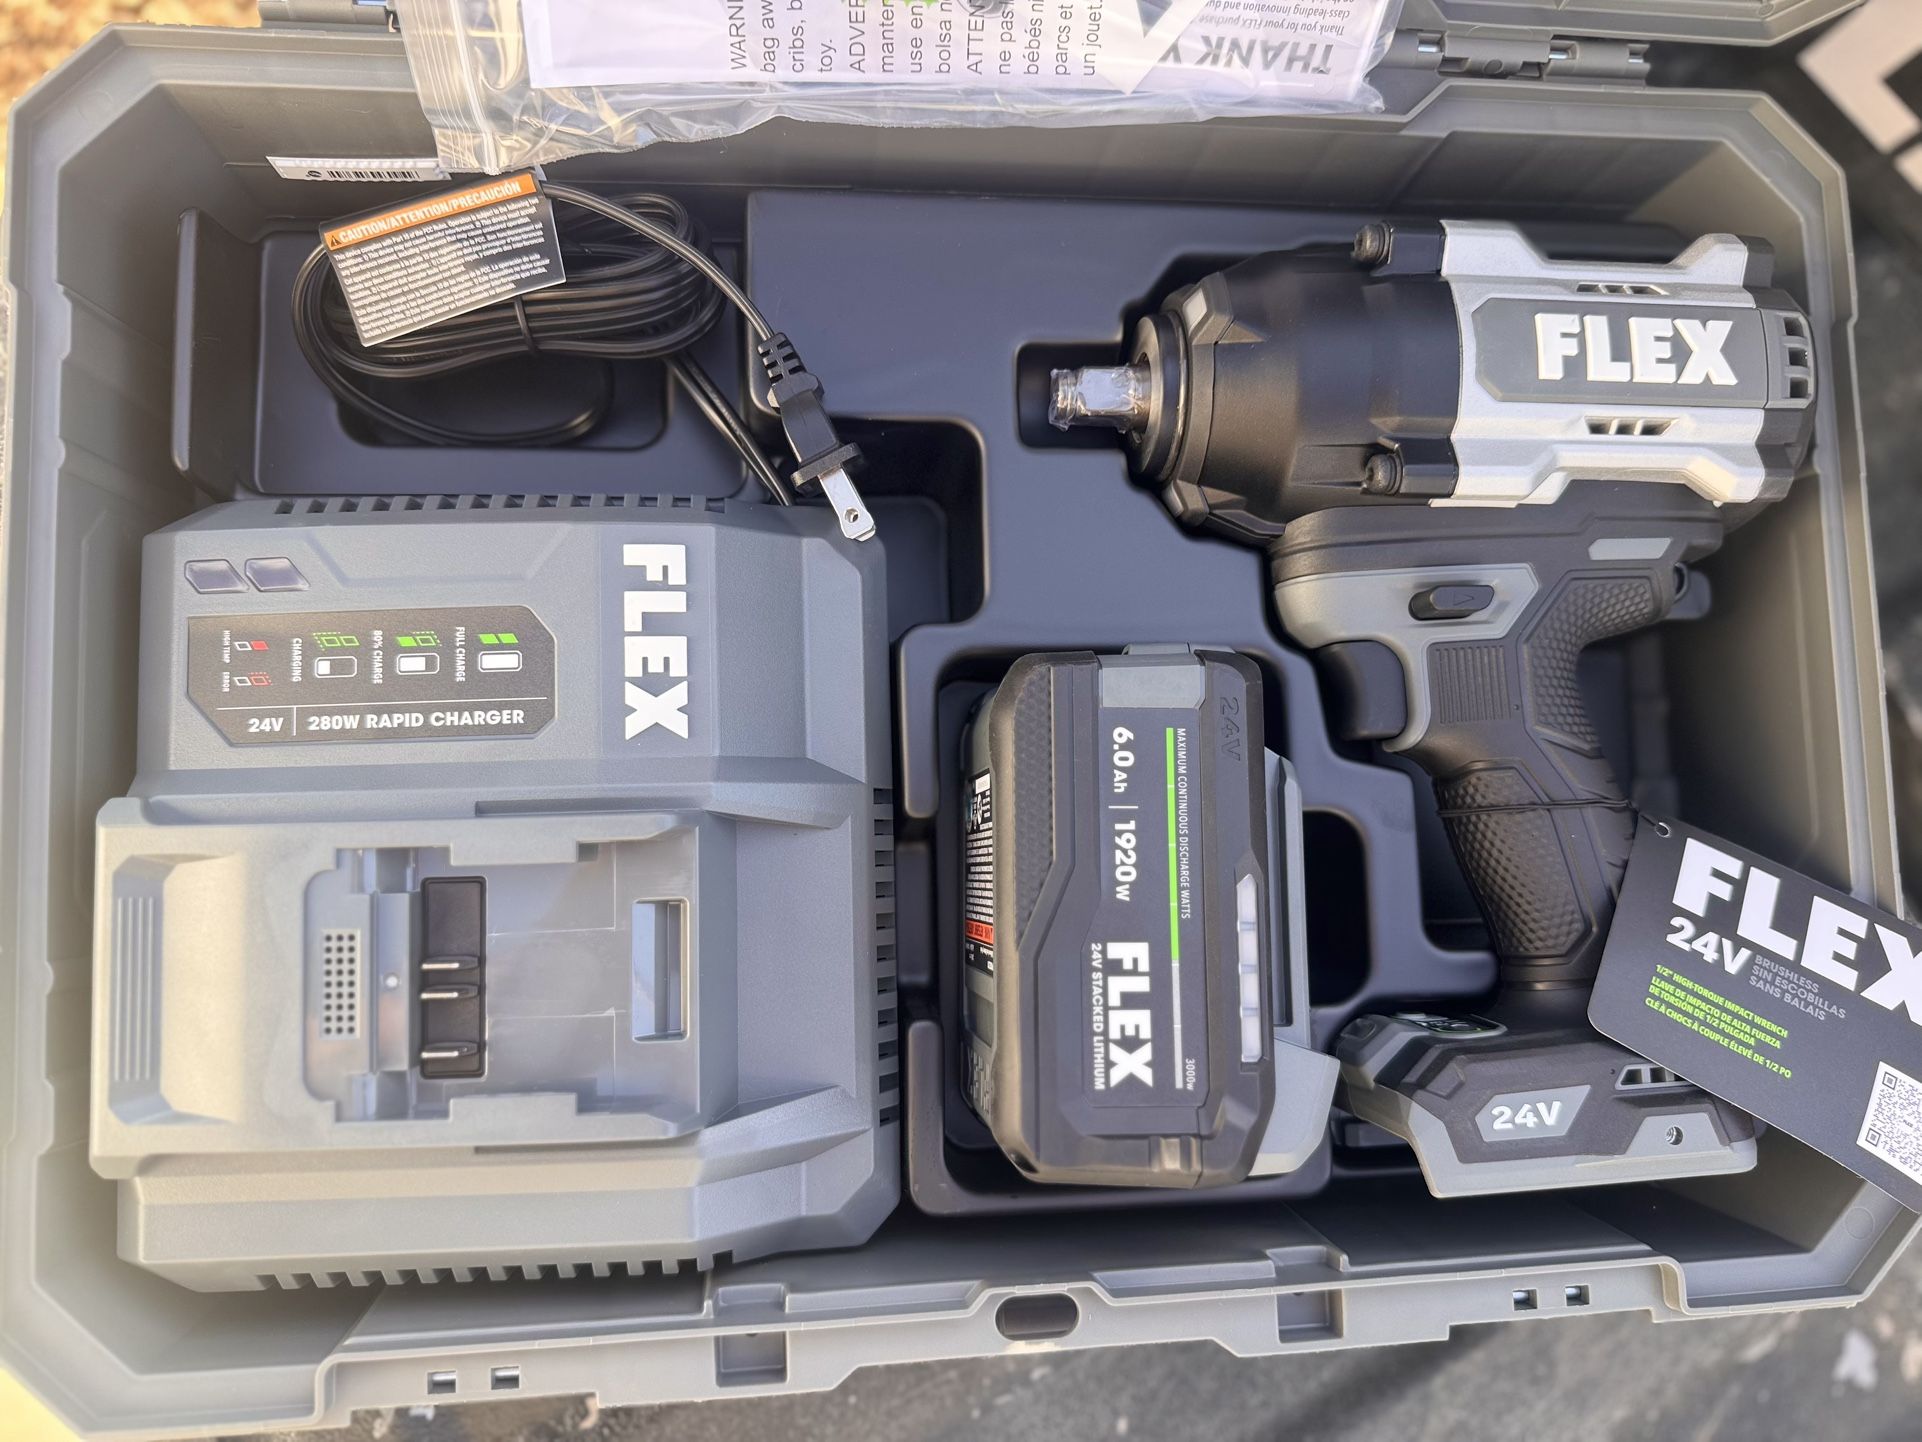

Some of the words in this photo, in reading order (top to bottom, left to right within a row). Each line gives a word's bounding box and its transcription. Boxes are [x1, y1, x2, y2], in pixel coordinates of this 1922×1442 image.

[910, 5, 922, 29] en
[1057, 4, 1073, 19] et
[1223, 0, 1241, 9] and
[1242, 2, 1291, 15] innovation
[1263, 18, 1285, 28] your
[1293, 3, 1350, 20] class-leading
[965, 0, 985, 76] ATTEN
[998, 9, 1016, 42] pas
[1241, 18, 1263, 29] FLEX
[1285, 21, 1299, 32] for
[1300, 21, 1317, 31] you
[1318, 24, 1344, 35] Thank
[760, 37, 779, 72] bag
[788, 19, 805, 72] cribs,
[817, 39, 836, 72] toy.
[910, 36, 922, 72] use
[934, 20, 951, 73] bolsa
[998, 50, 1011, 74] ne
[1022, 18, 1042, 74] bébés
[1054, 25, 1070, 75] parcs
[1194, 35, 1334, 74] THANK
[1083, 53, 1095, 76] un
[339, 180, 522, 243] CAUTION/ATTENTION/PRECAUCIÓN
[1535, 313, 1738, 386] FLEX
[222, 630, 230, 645] HIGH
[222, 646, 230, 663] TEMP
[372, 630, 382, 648] 80%
[455, 626, 465, 646] FULL
[623, 544, 689, 740] FLEX
[291, 637, 302, 681] CHARGING
[372, 650, 382, 683] CHARGE
[455, 648, 465, 681] CHARGE
[248, 717, 283, 732] 24V
[307, 714, 359, 730] 280W
[365, 712, 423, 728] RAPID
[430, 709, 523, 726] CHARGER
[1219, 696, 1241, 762] 24V
[1176, 728, 1186, 773] MAXIMUM
[1177, 775, 1188, 834] CONTINUOUS
[1176, 836, 1189, 887] DISCHARGE
[1180, 889, 1190, 918] WATTS
[1666, 916, 1750, 973] 24V
[1672, 837, 1922, 1026] FLEX
[1091, 943, 1102, 968] 24V
[1755, 954, 1818, 992] BRUSHLESS
[1091, 971, 1103, 1032] STACKED
[1656, 964, 1673, 976] 1/2"
[1672, 973, 1724, 1005] HIGH-TORQUE
[1724, 999, 1755, 1020] IMPACT
[1754, 1014, 1787, 1037] WRENCH
[1749, 975, 1781, 997] SANS
[1783, 992, 1825, 1020] BALAIS
[1752, 965, 1772, 981] SIN
[1774, 976, 1845, 1018] ESCOBILLAS
[1103, 942, 1152, 1086] FLEX
[1648, 984, 1660, 996] DE
[1660, 990, 1694, 1013] TORSIÓN
[1693, 1008, 1705, 1019] DE
[1706, 1014, 1719, 1027] 1/2
[1719, 1021, 1754, 1045] PULGADA
[1651, 976, 1675, 993] LLAVE
[1674, 988, 1686, 999] DE
[1684, 994, 1720, 1017] IMPACTO
[1720, 1012, 1732, 1023] DE
[1731, 1018, 1750, 1033] ALTA
[1751, 1028, 1780, 1048] FUERZA
[1645, 997, 1659, 1009] CLÉ
[1658, 1003, 1665, 1013] À
[1665, 1008, 1692, 1027] CHOCS
[1691, 1020, 1698, 1031] À
[1698, 1025, 1729, 1046] COUPLE
[1728, 1040, 1752, 1058] ÉLEVÉ
[1752, 1053, 1764, 1064] DE
[1765, 1059, 1778, 1072] 1/2
[1779, 1066, 1791, 1077] PO
[1093, 1036, 1105, 1089] LITHIUM
[1491, 1101, 1562, 1130] 24V
